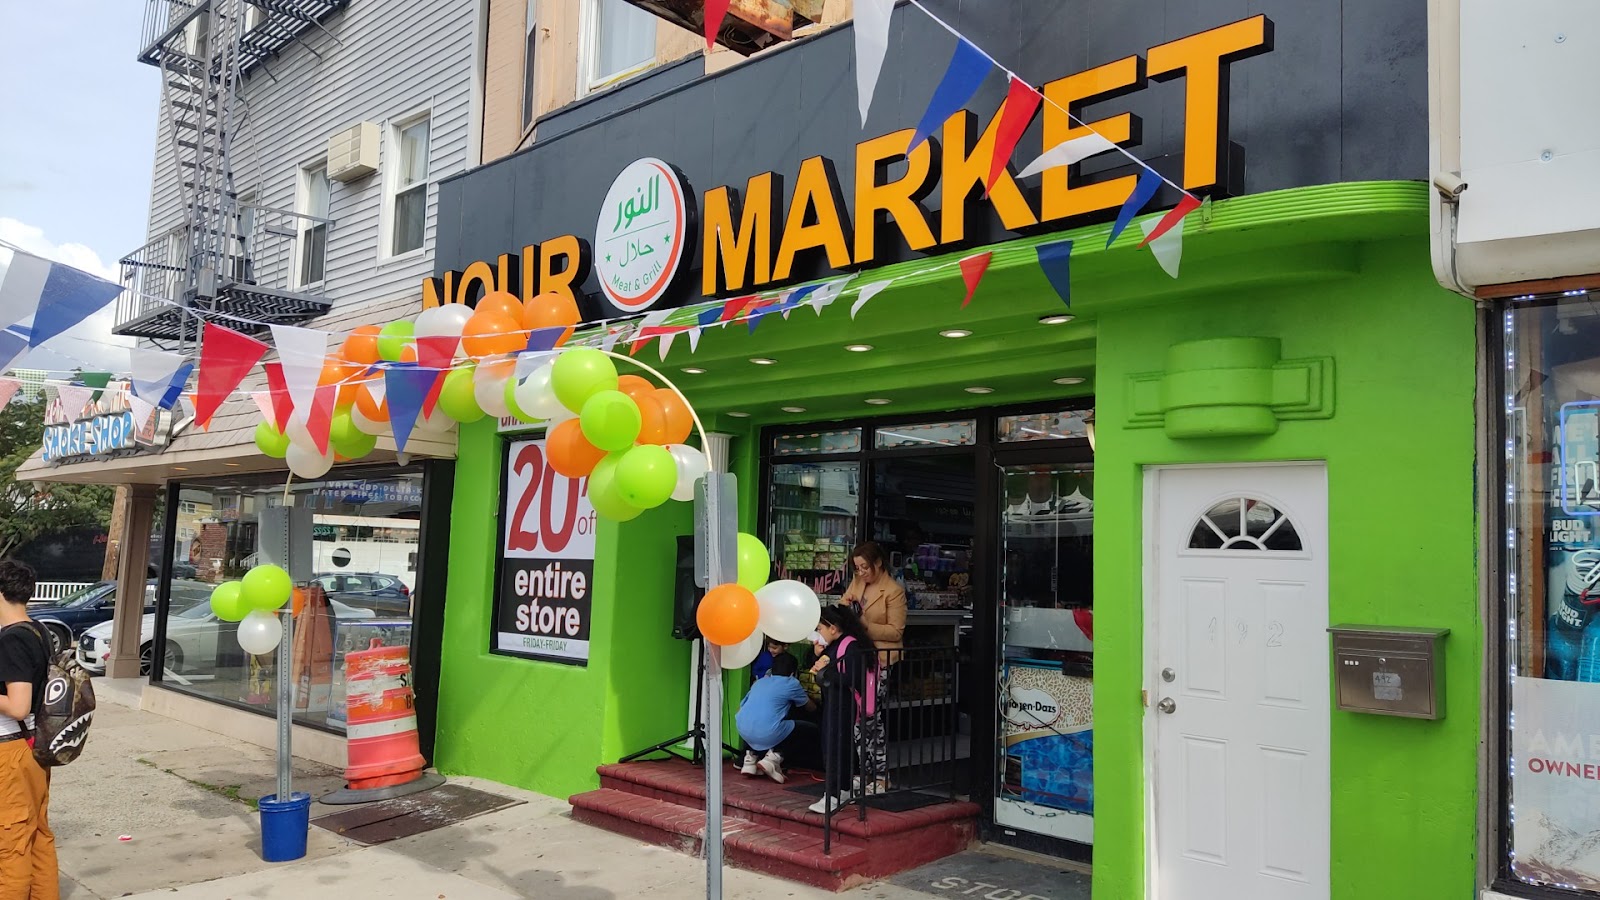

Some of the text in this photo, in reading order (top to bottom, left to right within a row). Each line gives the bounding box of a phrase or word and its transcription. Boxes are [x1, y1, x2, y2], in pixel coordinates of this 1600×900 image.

[702, 14, 1268, 296] MARKET
[613, 174, 660, 233] النور
[619, 238, 654, 267] حلال
[612, 260, 662, 292] Meat & Grill
[42, 421, 87, 462] SMOKE
[90, 412, 133, 455] SHOP
[312, 488, 346, 498] WATER
[385, 494, 420, 502] TOBACC
[508, 444, 597, 553] 20 of
[1552, 520, 1585, 531] BUD
[515, 562, 586, 599] entire
[814, 563, 848, 593] MEAT
[516, 597, 580, 636] store
[523, 637, 567, 651] FRIDAY-FRIDAY
[1528, 758, 1600, 781] OWNE
